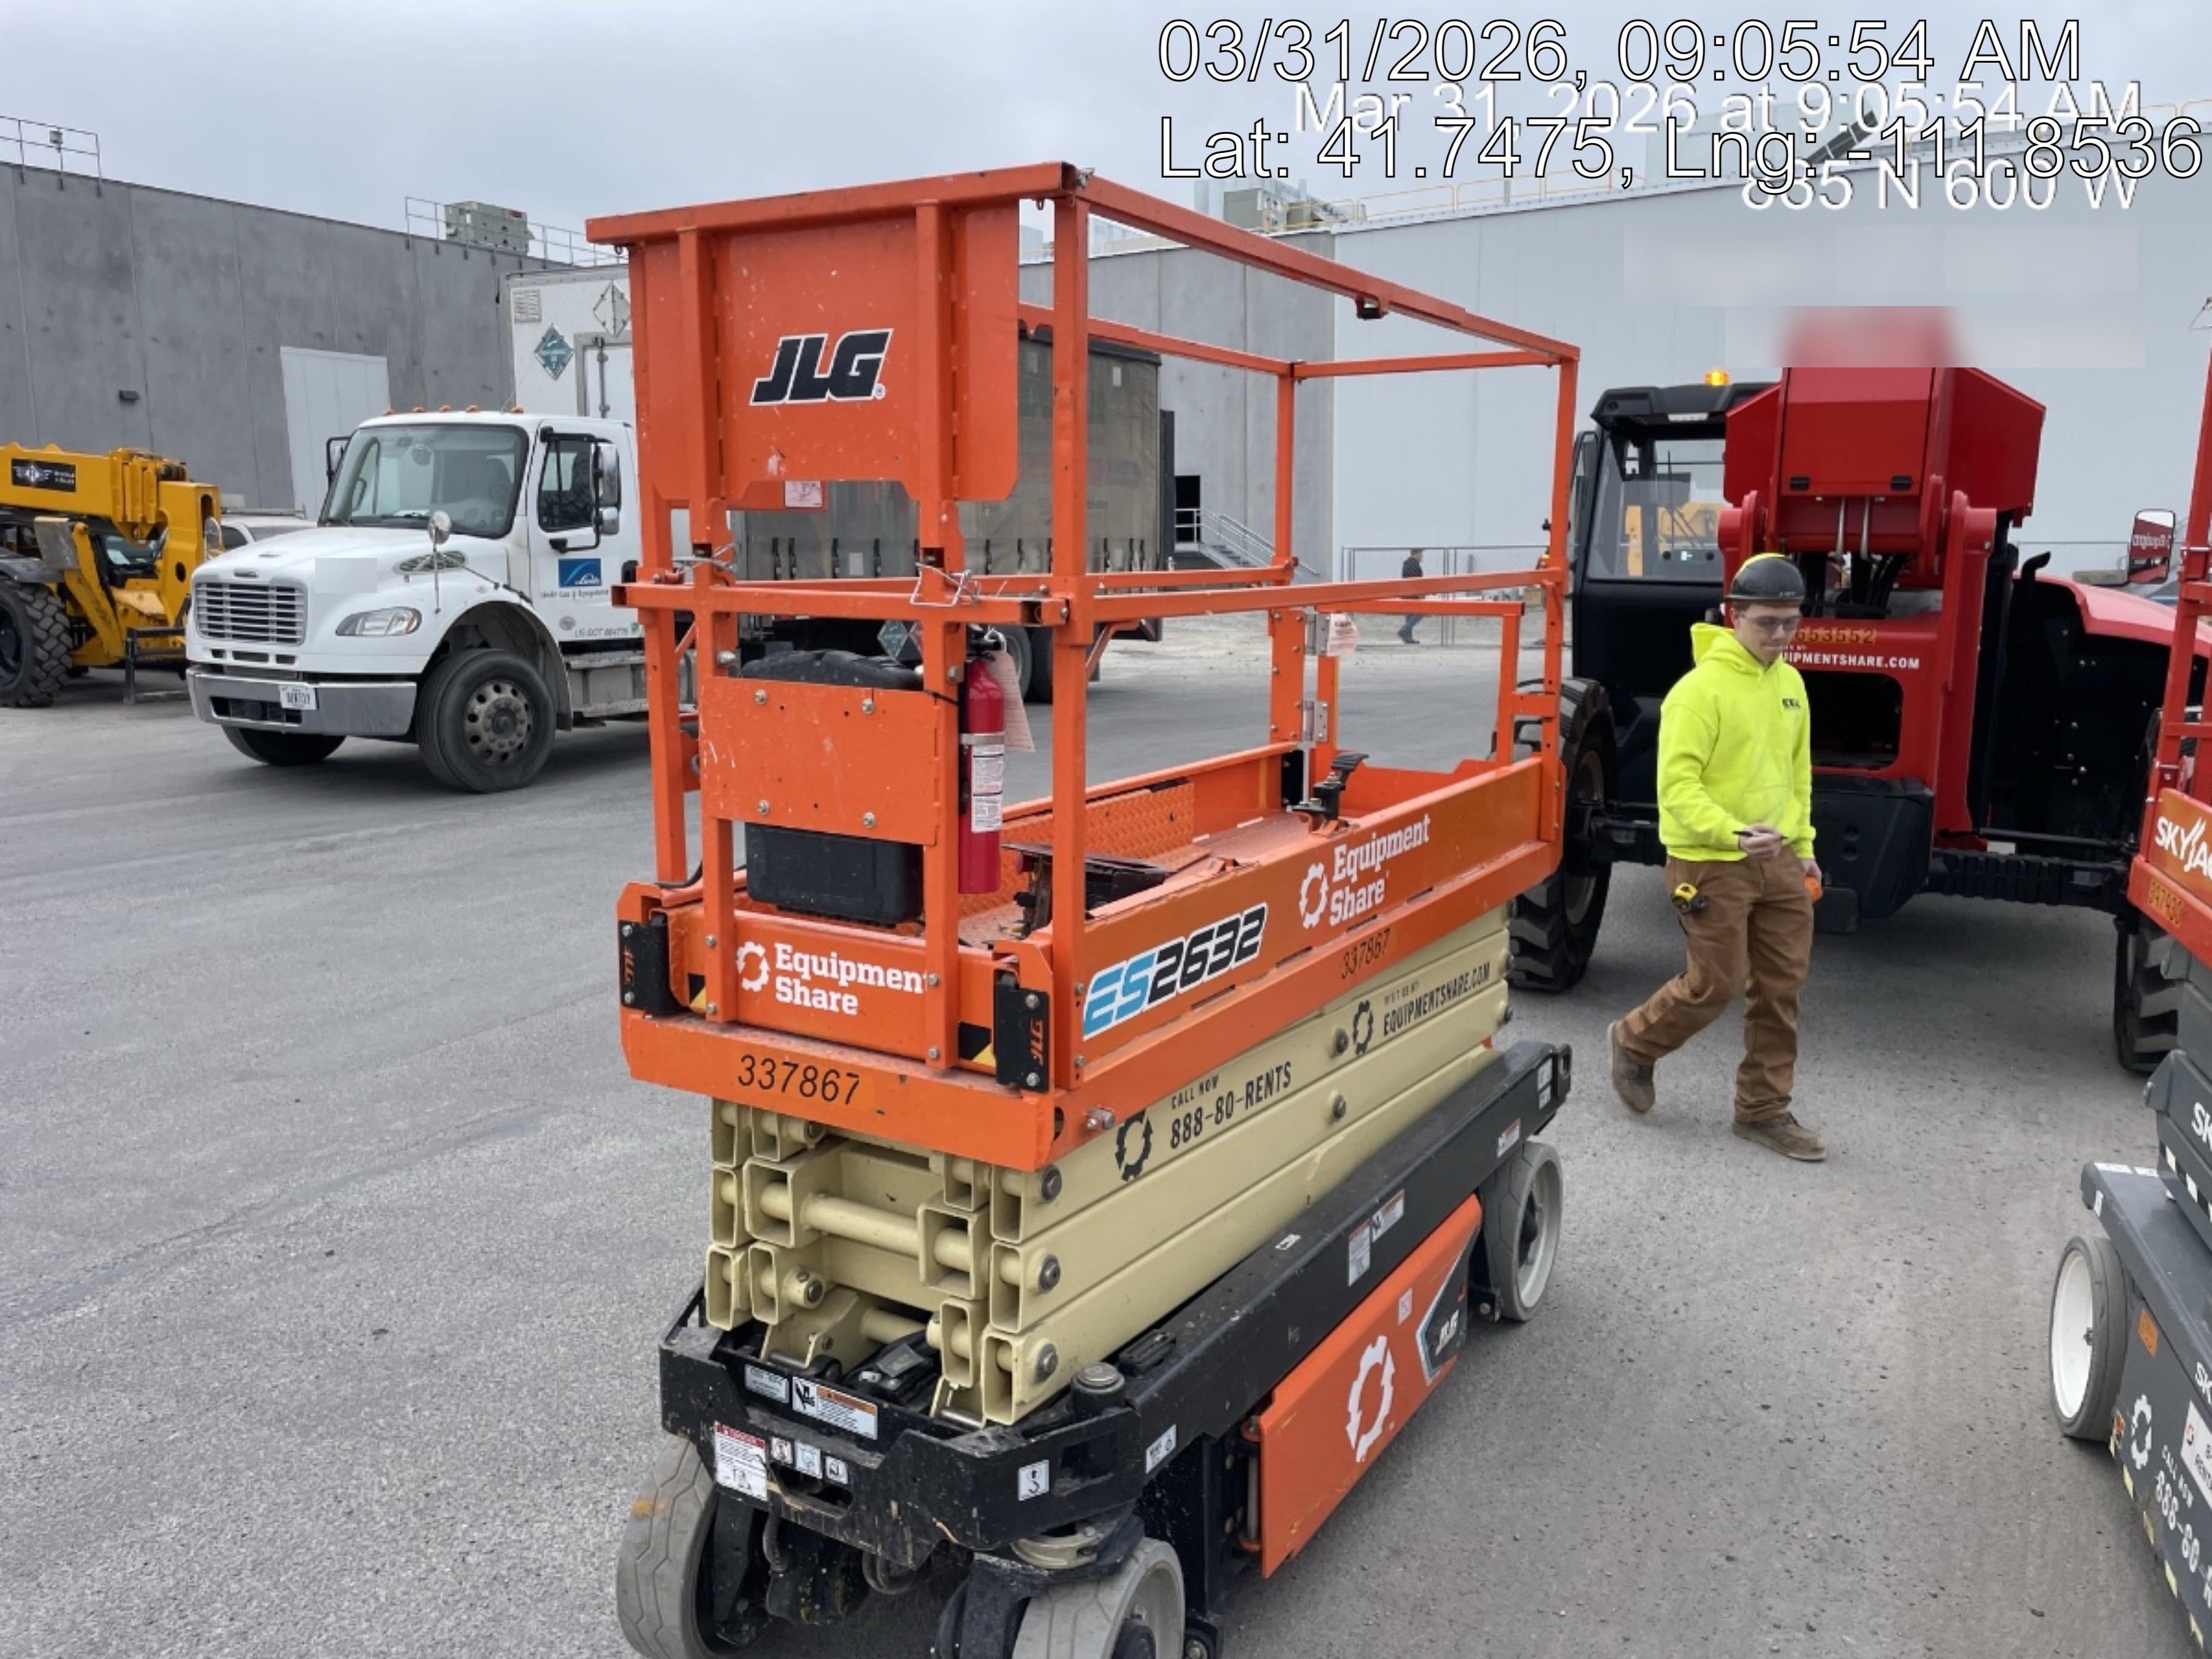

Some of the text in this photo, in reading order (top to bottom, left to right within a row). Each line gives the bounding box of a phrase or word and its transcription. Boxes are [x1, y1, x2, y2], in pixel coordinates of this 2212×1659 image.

[748, 327, 894, 406] JLG
[1783, 652, 1920, 669] UIPMENTSHARE.COM
[1332, 814, 1430, 882] Equipment
[1329, 877, 1386, 926] Share
[774, 942, 927, 994] Equipmen
[1083, 901, 1268, 1041] ES2632
[775, 976, 858, 1015] Share
[1384, 961, 1490, 1037] EQUIPMENTSHARE.COM
[1030, 1018, 1043, 1067] JLG
[738, 1054, 860, 1105] 337867
[1171, 1061, 1291, 1149] 888-80-RENTS
[1172, 1074, 1219, 1110] CALL NOW
